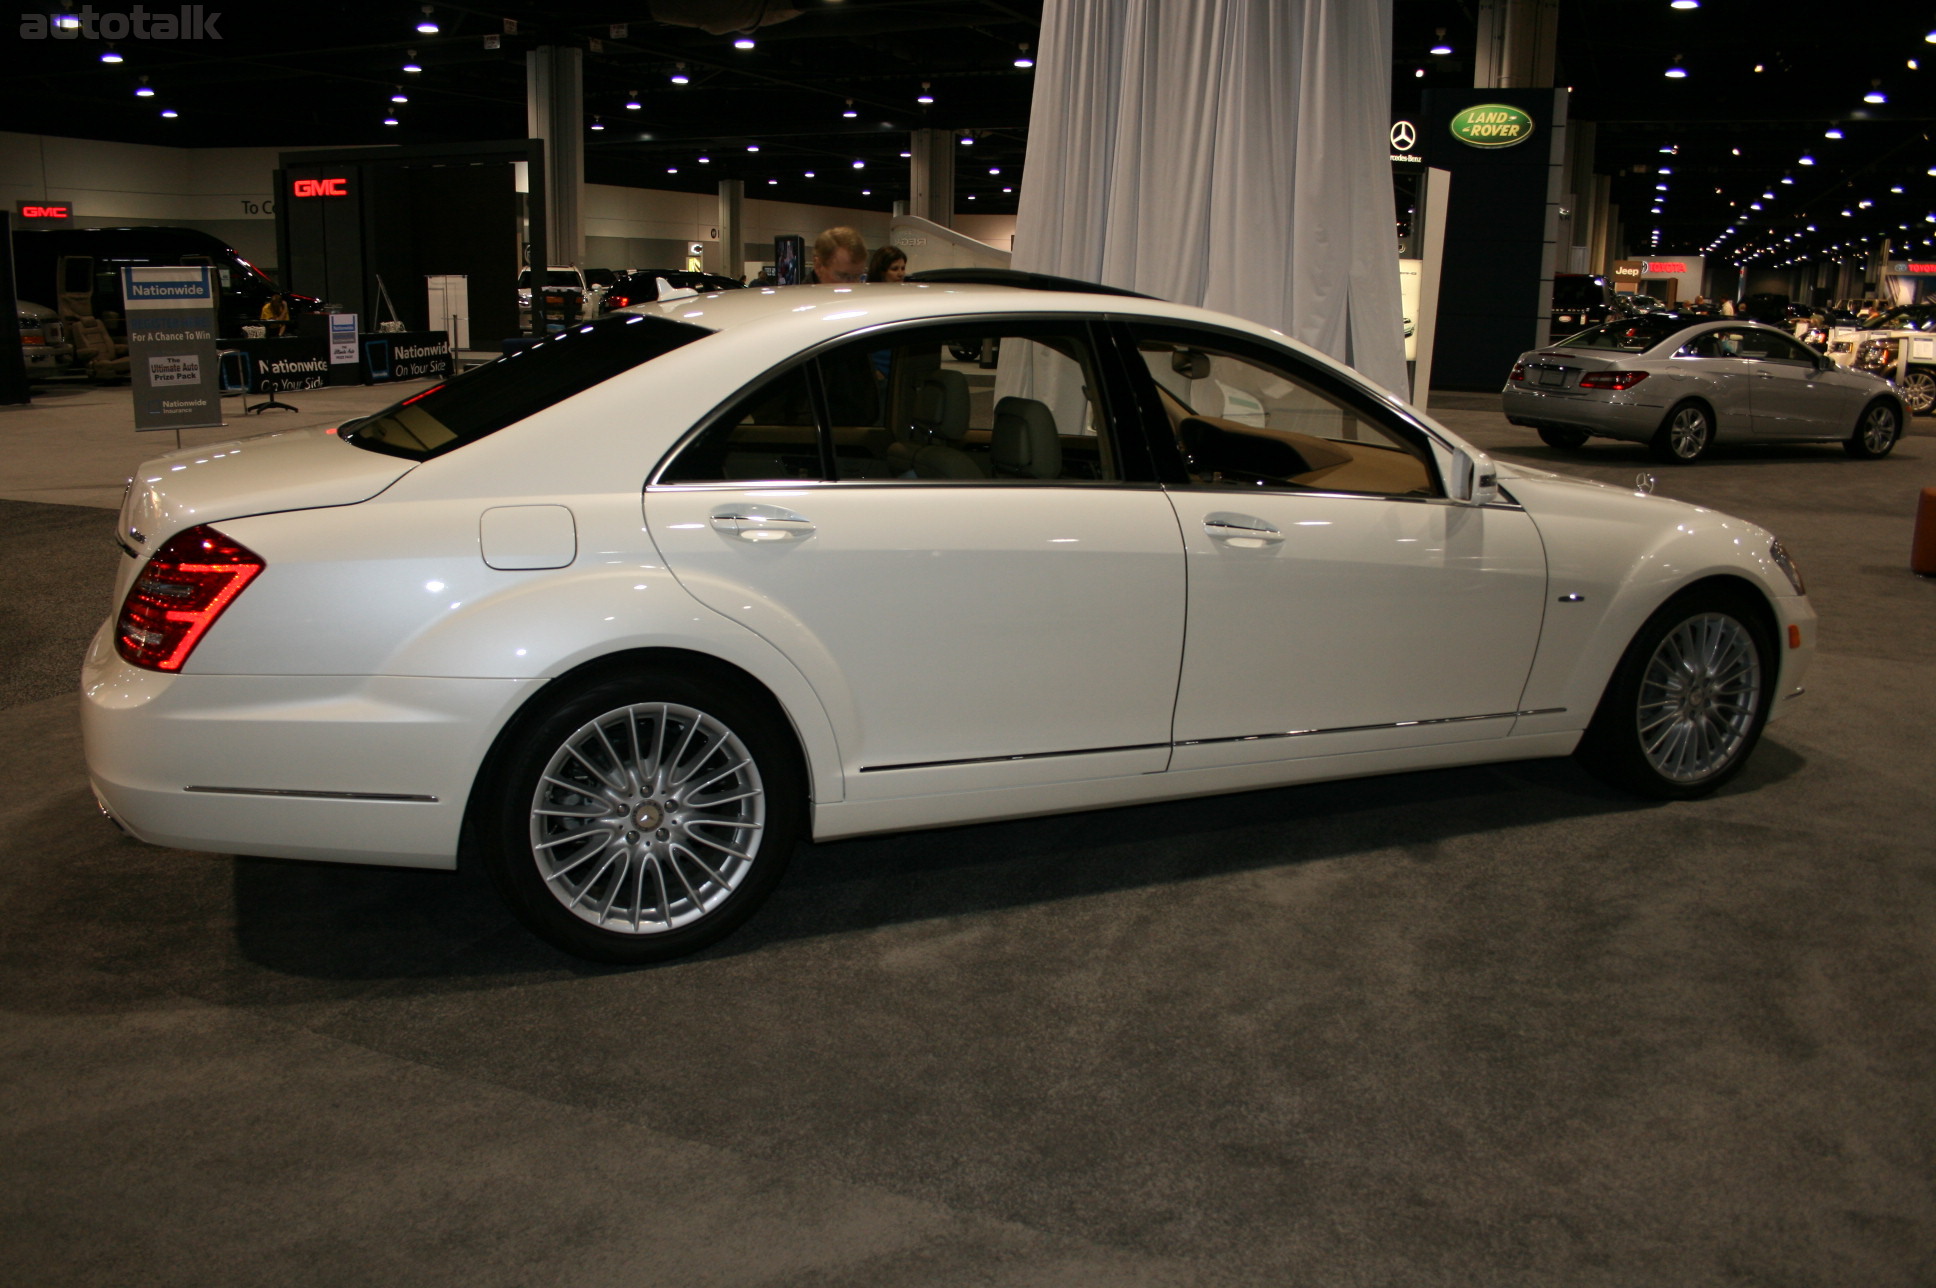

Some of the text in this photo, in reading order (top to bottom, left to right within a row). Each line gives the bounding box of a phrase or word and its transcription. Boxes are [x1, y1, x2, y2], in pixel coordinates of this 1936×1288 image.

[1467, 112, 1508, 124] LAND
[1470, 124, 1520, 137] ROVER
[294, 178, 348, 197] GMC
[22, 206, 69, 218] GMC
[241, 200, 259, 215] To
[1615, 266, 1639, 277] Jeep
[1649, 262, 1686, 273] TOYOTA
[132, 284, 204, 296] Nationwide
[132, 330, 211, 342] For A Chance To Win
[151, 363, 198, 374] Ultimate Auto
[395, 364, 408, 377] On
[410, 363, 428, 375] Your
[154, 372, 196, 381] Prize Pack
[162, 399, 207, 408] Nationwide
[163, 407, 193, 415] Insurance
